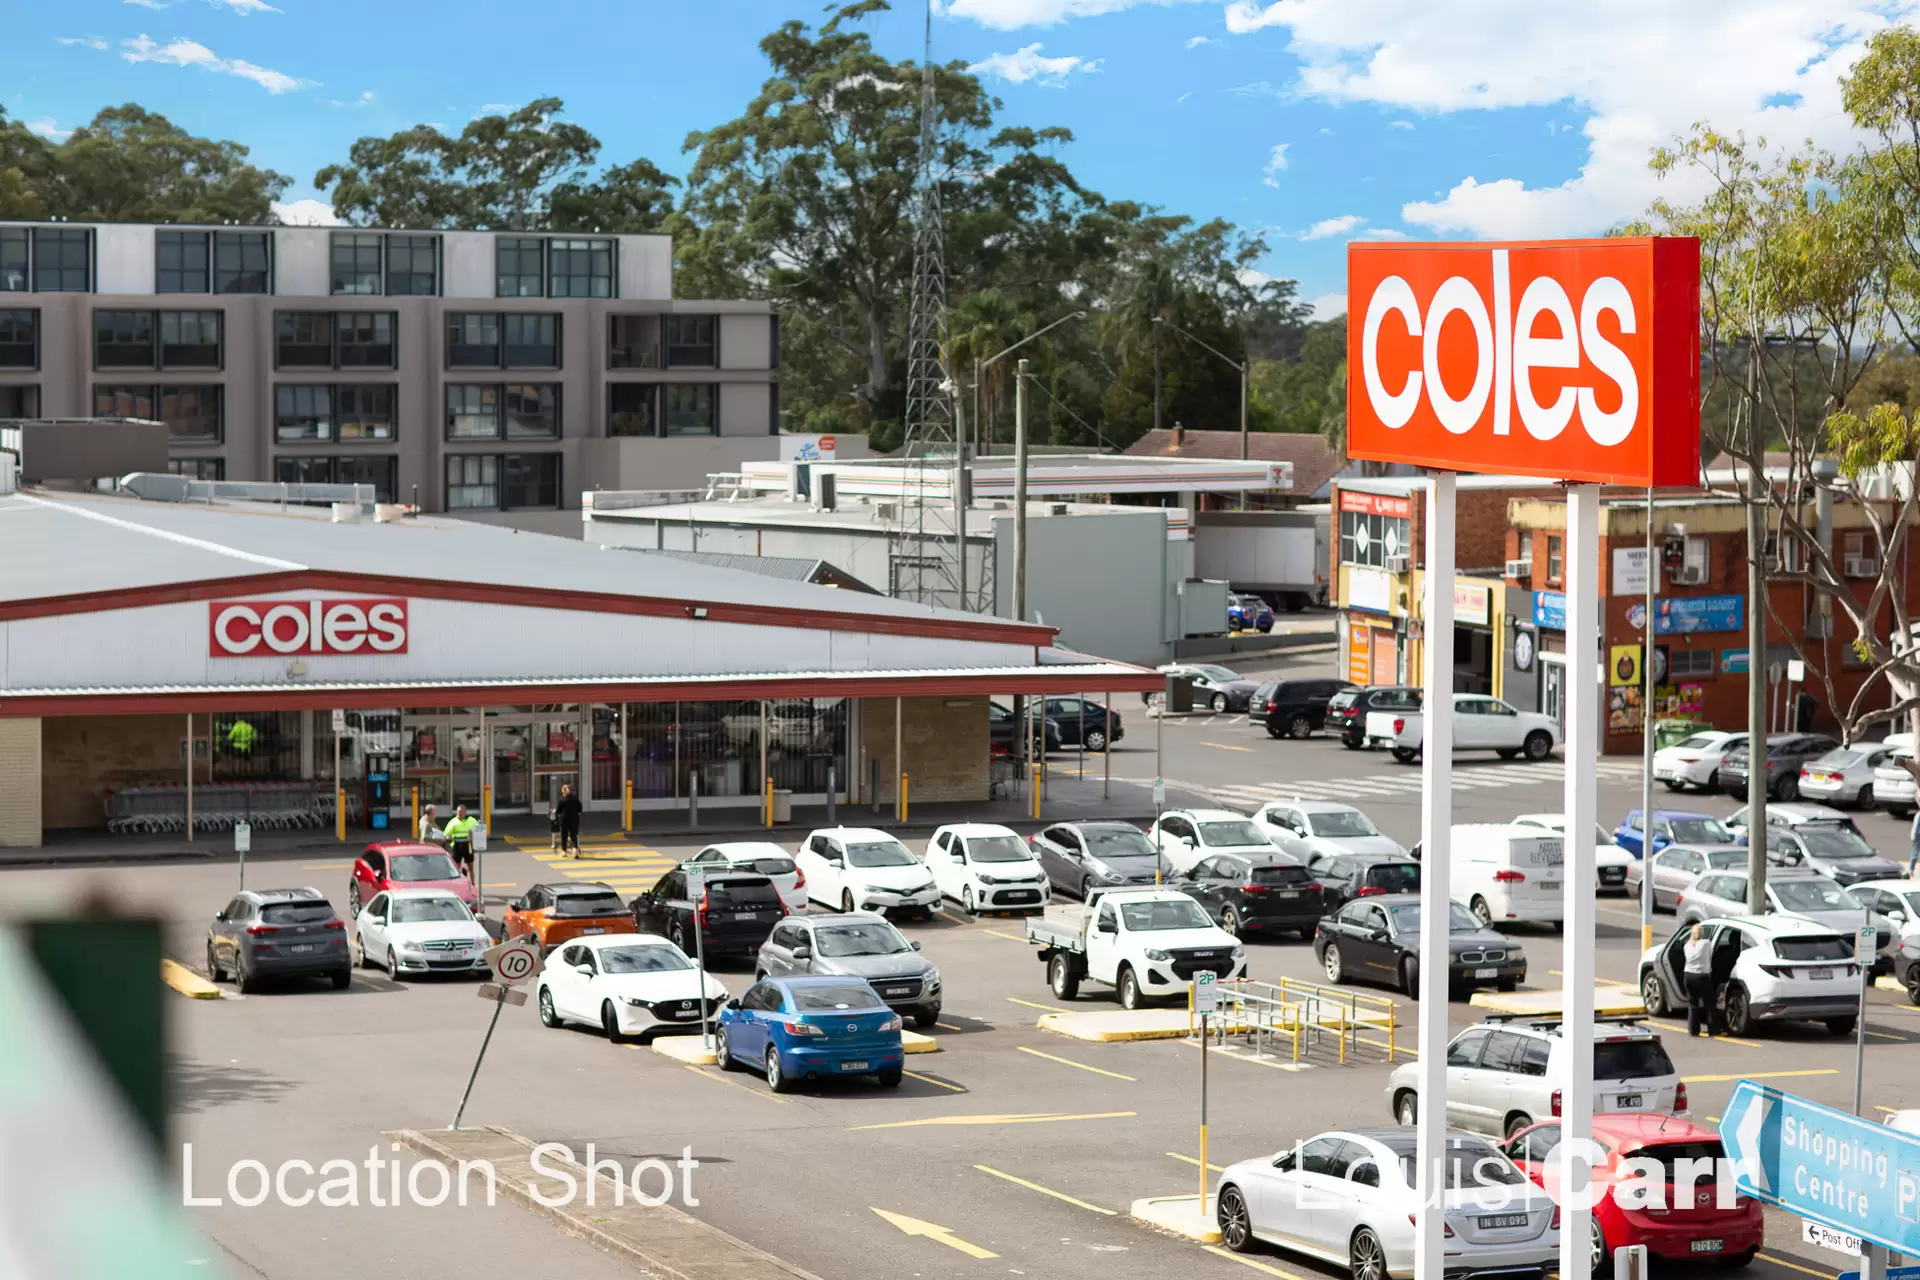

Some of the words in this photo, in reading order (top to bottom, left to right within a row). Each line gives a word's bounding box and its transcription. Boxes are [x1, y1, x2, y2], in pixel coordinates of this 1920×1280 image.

[1362, 249, 1639, 446] coles
[215, 600, 405, 654] coles
[689, 867, 702, 875] 2P
[1861, 927, 1875, 937] 2P
[507, 957, 527, 972] 10
[1199, 974, 1215, 985] 2P
[1784, 1115, 1888, 1188] Shopping
[1795, 1163, 1870, 1218] Centre
[1822, 1229, 1841, 1246] Post
